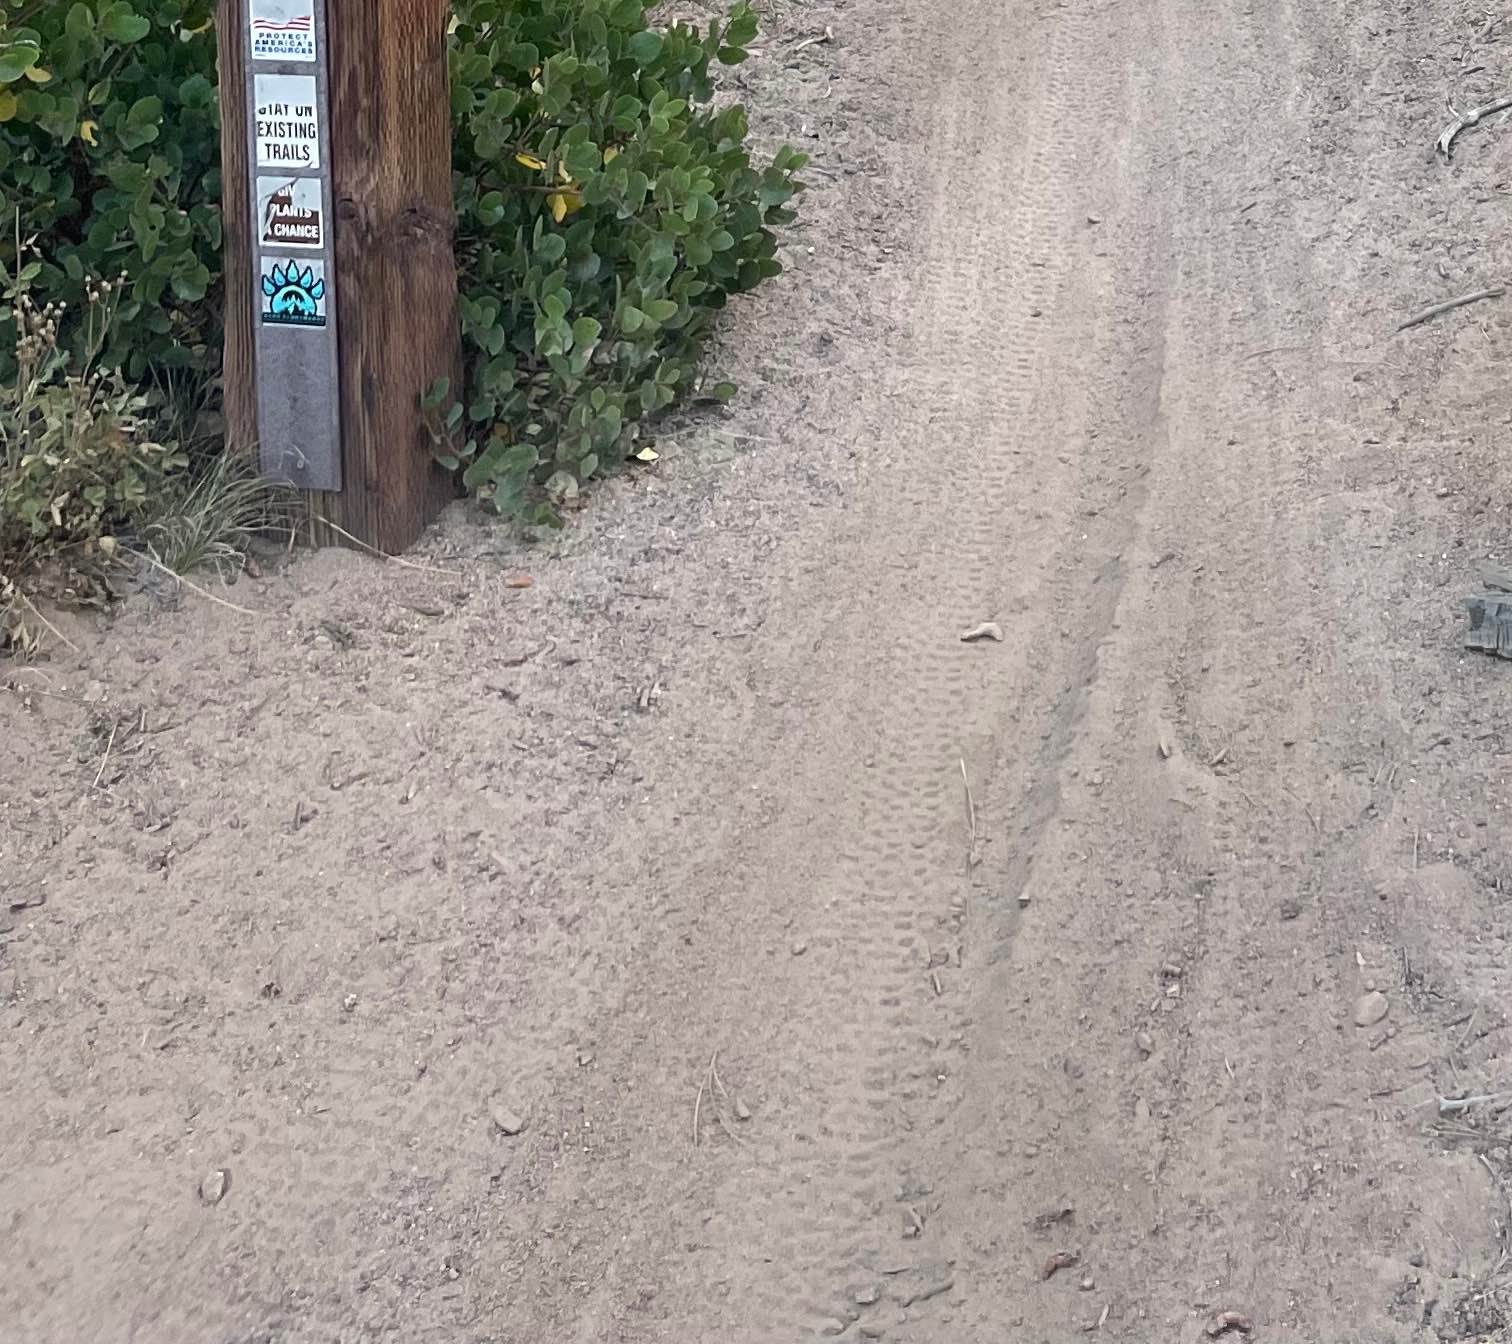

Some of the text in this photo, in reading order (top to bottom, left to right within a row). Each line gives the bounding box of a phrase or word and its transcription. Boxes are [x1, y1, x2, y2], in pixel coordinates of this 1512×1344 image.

[259, 32, 308, 40] PROTECT
[255, 39, 313, 47] AMERICA'S
[255, 46, 313, 54] RESOURCES
[257, 121, 316, 139] EXISTING
[264, 143, 310, 161] TRAILS
[274, 223, 319, 239] CHANCE
